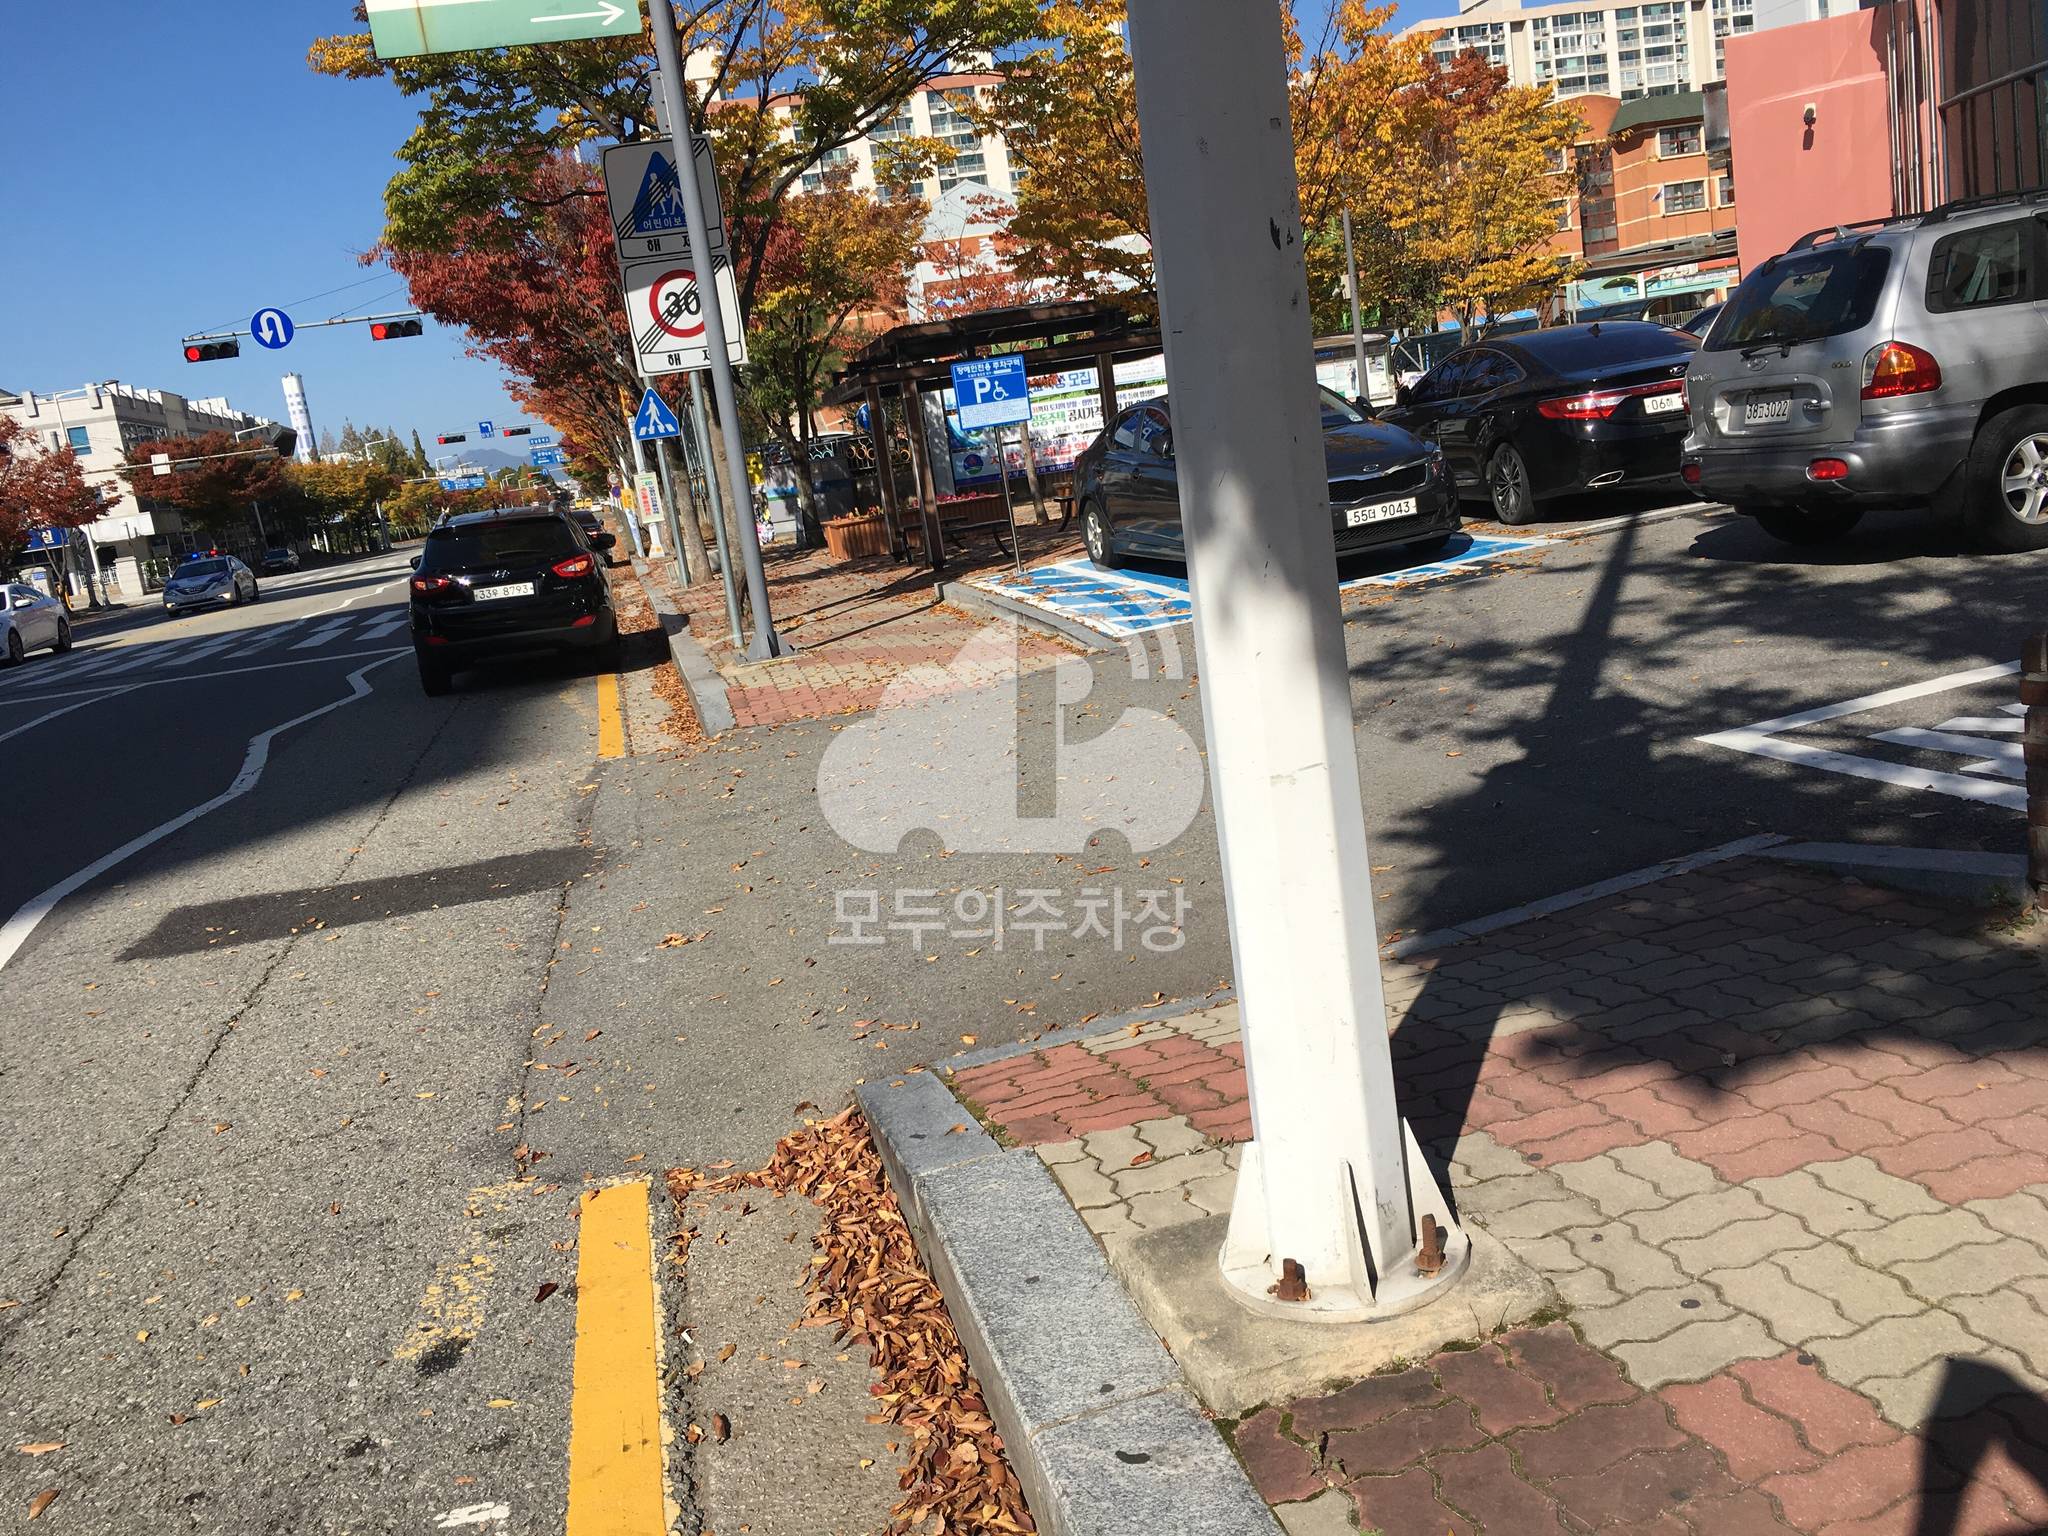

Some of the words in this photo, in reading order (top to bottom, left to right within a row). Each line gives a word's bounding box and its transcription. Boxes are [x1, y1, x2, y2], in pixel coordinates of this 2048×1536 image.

[643, 216, 687, 230] 어린이보
[647, 238, 661, 252] 해
[664, 290, 701, 318] 30
[667, 353, 682, 366] 해
[1068, 370, 1092, 388] 모집
[973, 377, 991, 404] P
[1353, 508, 1376, 524] 55더
[1380, 501, 1411, 517] 9043
[502, 584, 529, 597] 8793
